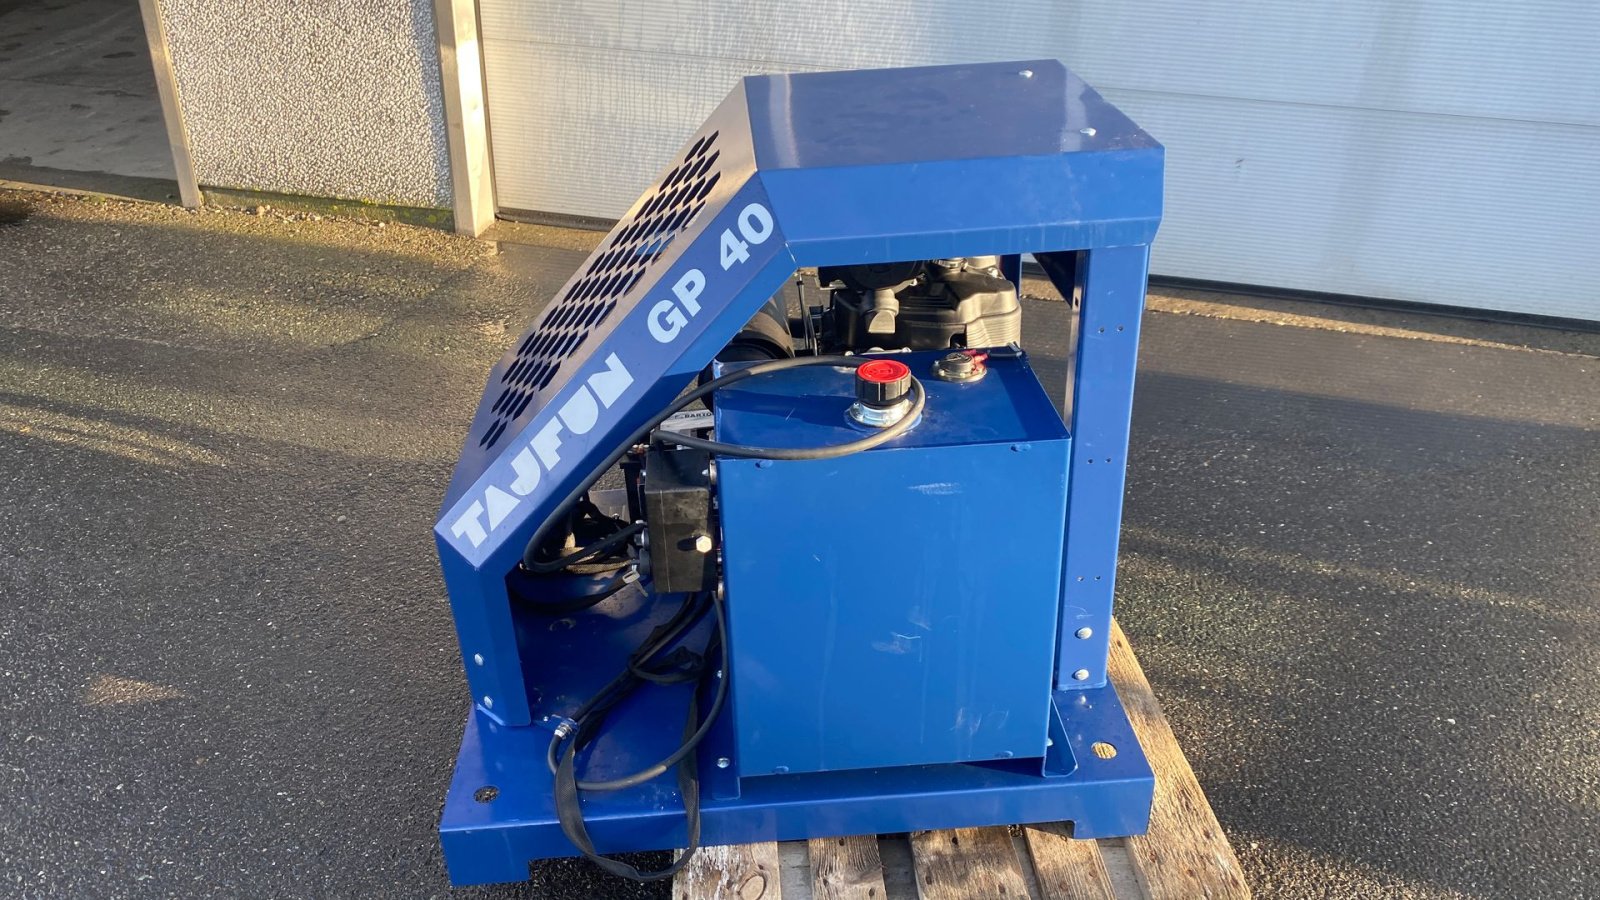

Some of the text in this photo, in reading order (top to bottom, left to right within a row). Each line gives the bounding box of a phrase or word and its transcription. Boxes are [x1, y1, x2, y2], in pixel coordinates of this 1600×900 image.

[451, 203, 774, 549] TAJFUN GP 40
